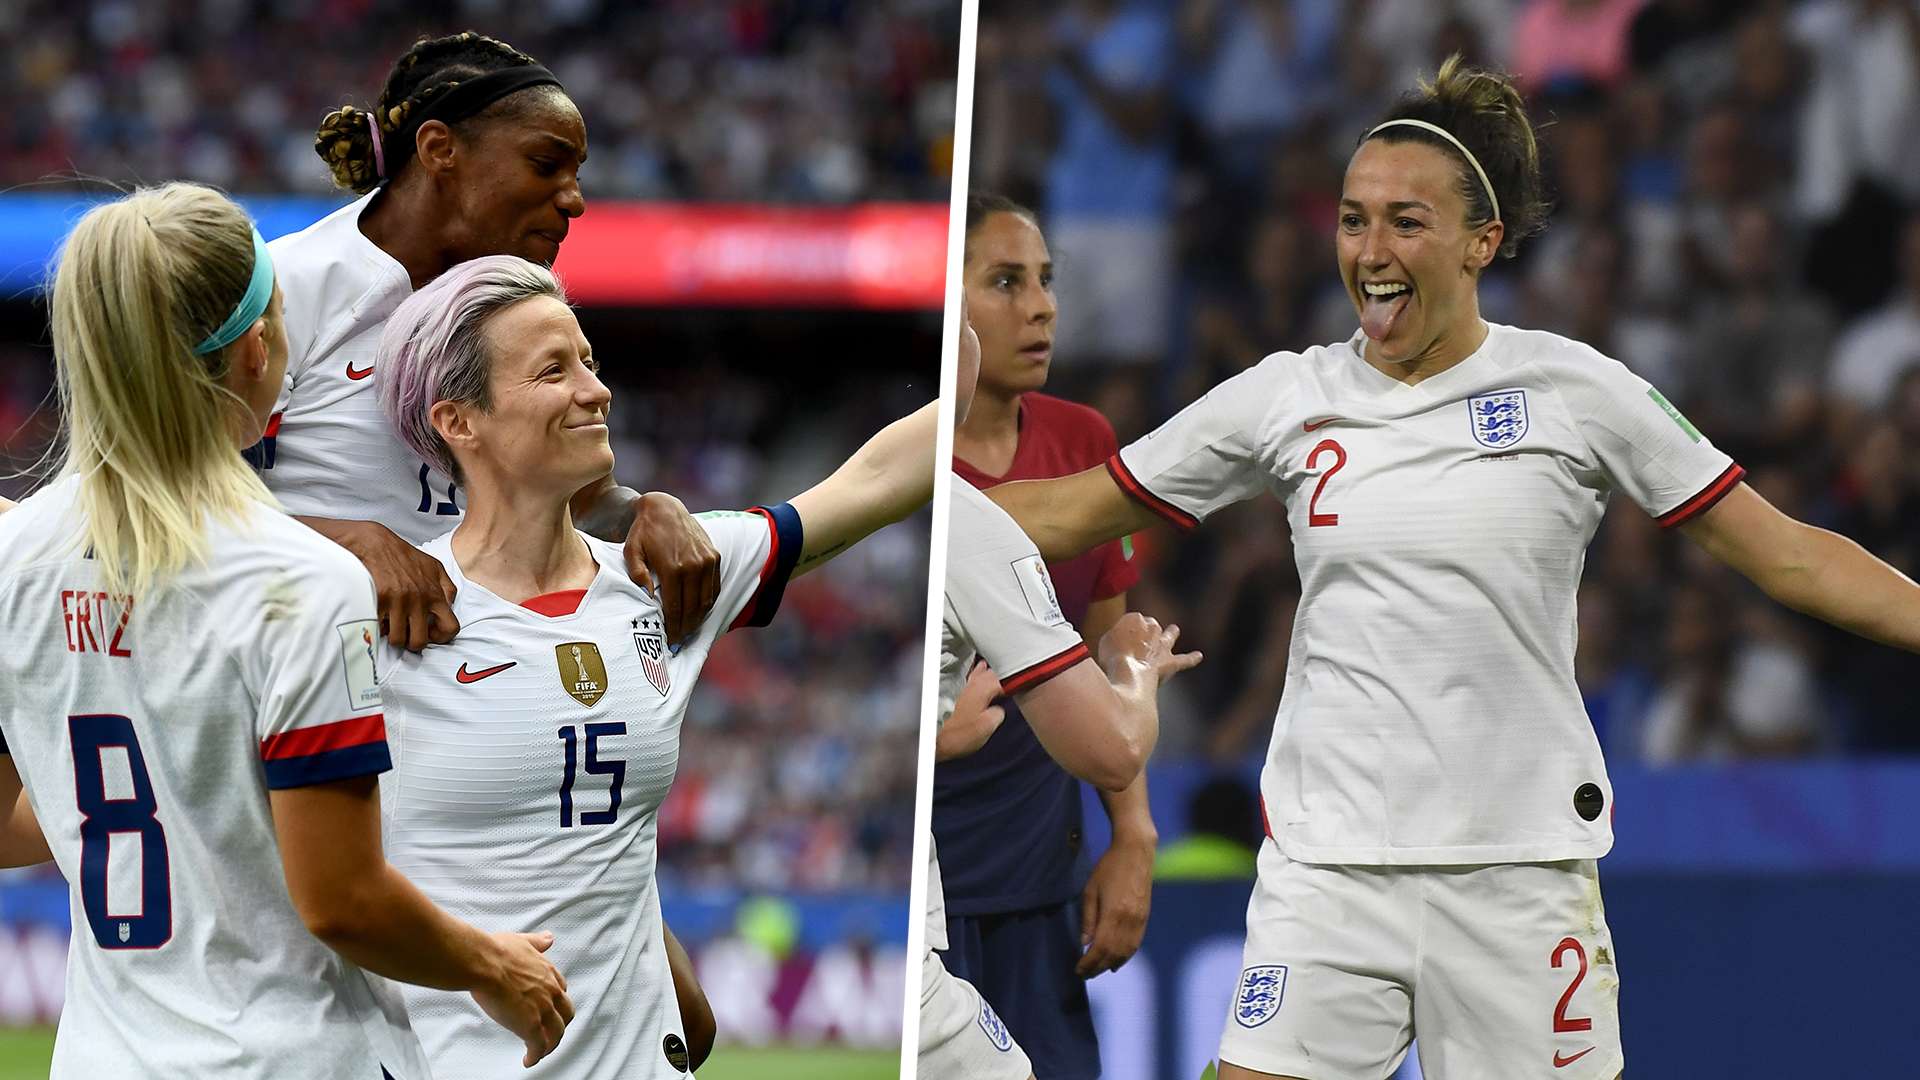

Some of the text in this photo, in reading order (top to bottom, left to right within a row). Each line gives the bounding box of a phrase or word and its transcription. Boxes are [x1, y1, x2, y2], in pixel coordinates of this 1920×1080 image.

[1306, 439, 1347, 527] 2
[61, 590, 134, 657] ERTZ
[637, 637, 662, 660] USA
[575, 681, 597, 691] FIFA
[557, 721, 627, 828] 15
[68, 714, 173, 950] 8
[1551, 937, 1592, 1033] 2
